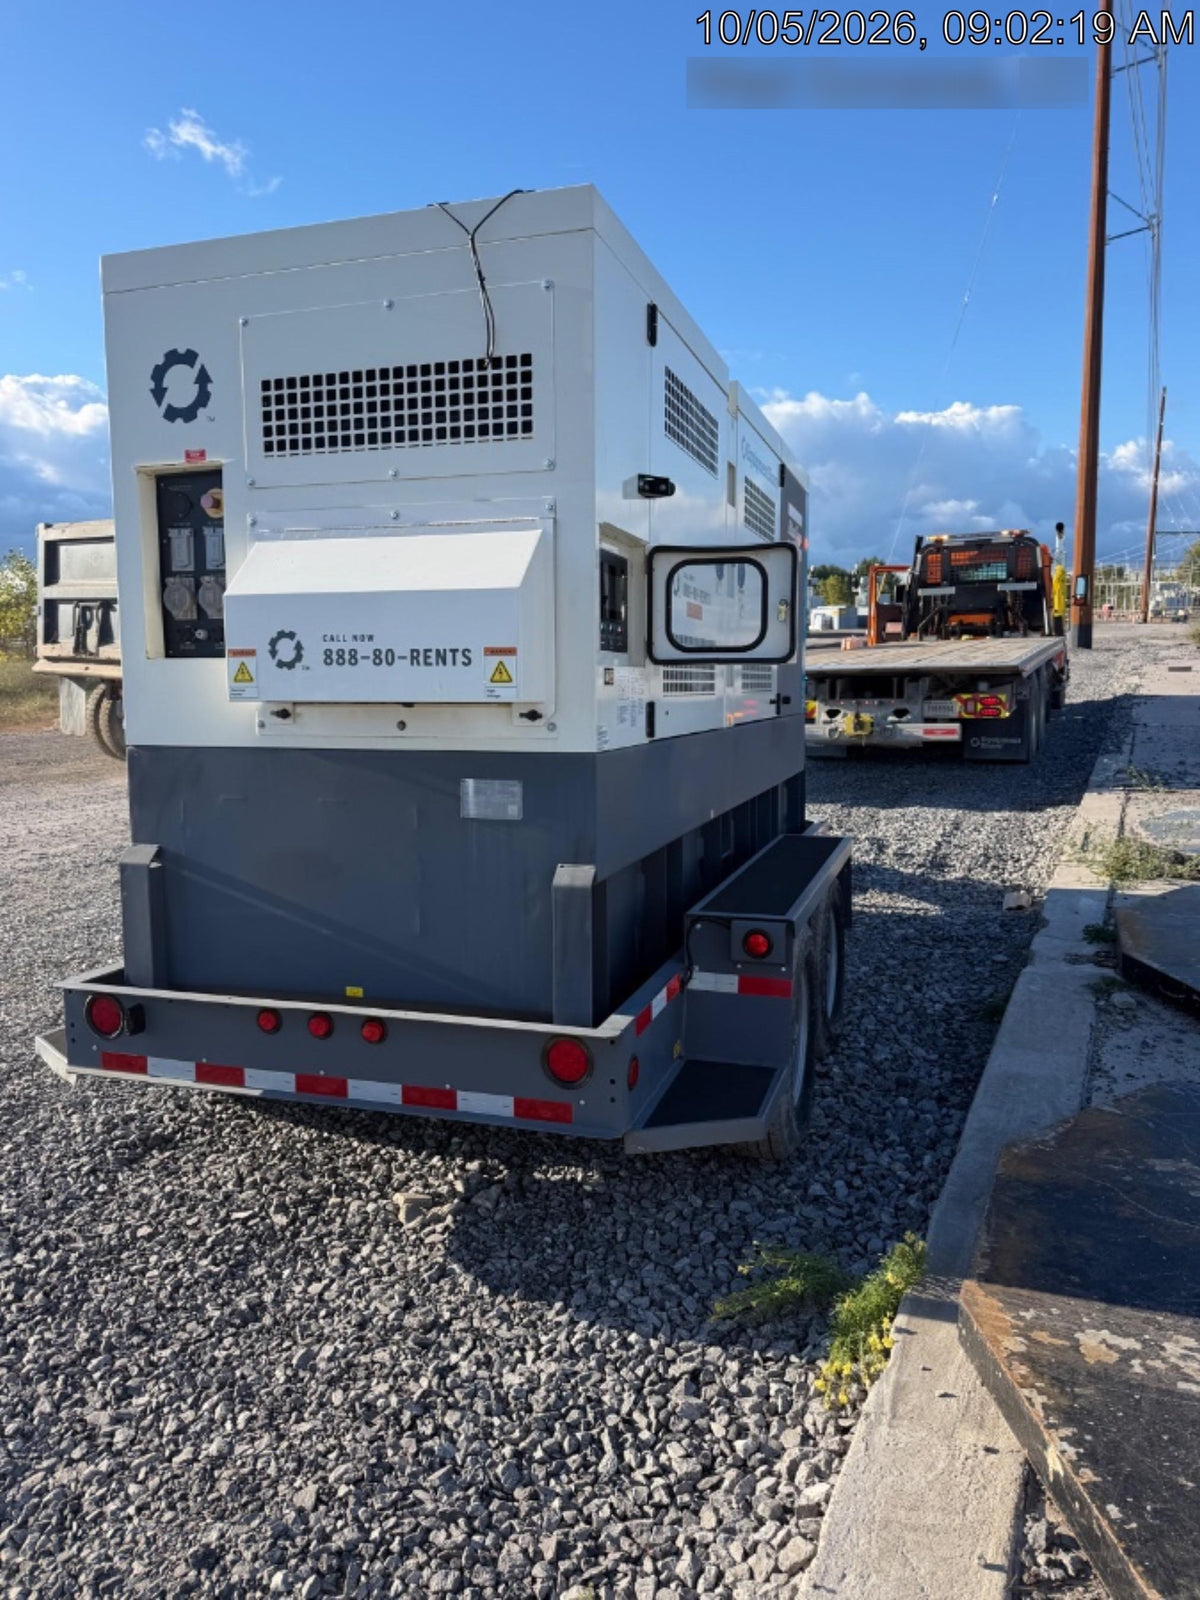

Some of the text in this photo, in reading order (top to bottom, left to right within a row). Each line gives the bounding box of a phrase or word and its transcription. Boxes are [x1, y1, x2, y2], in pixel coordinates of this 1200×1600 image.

[322, 633, 375, 643] CALL NOW
[322, 648, 473, 667] 888-80-RENTS
